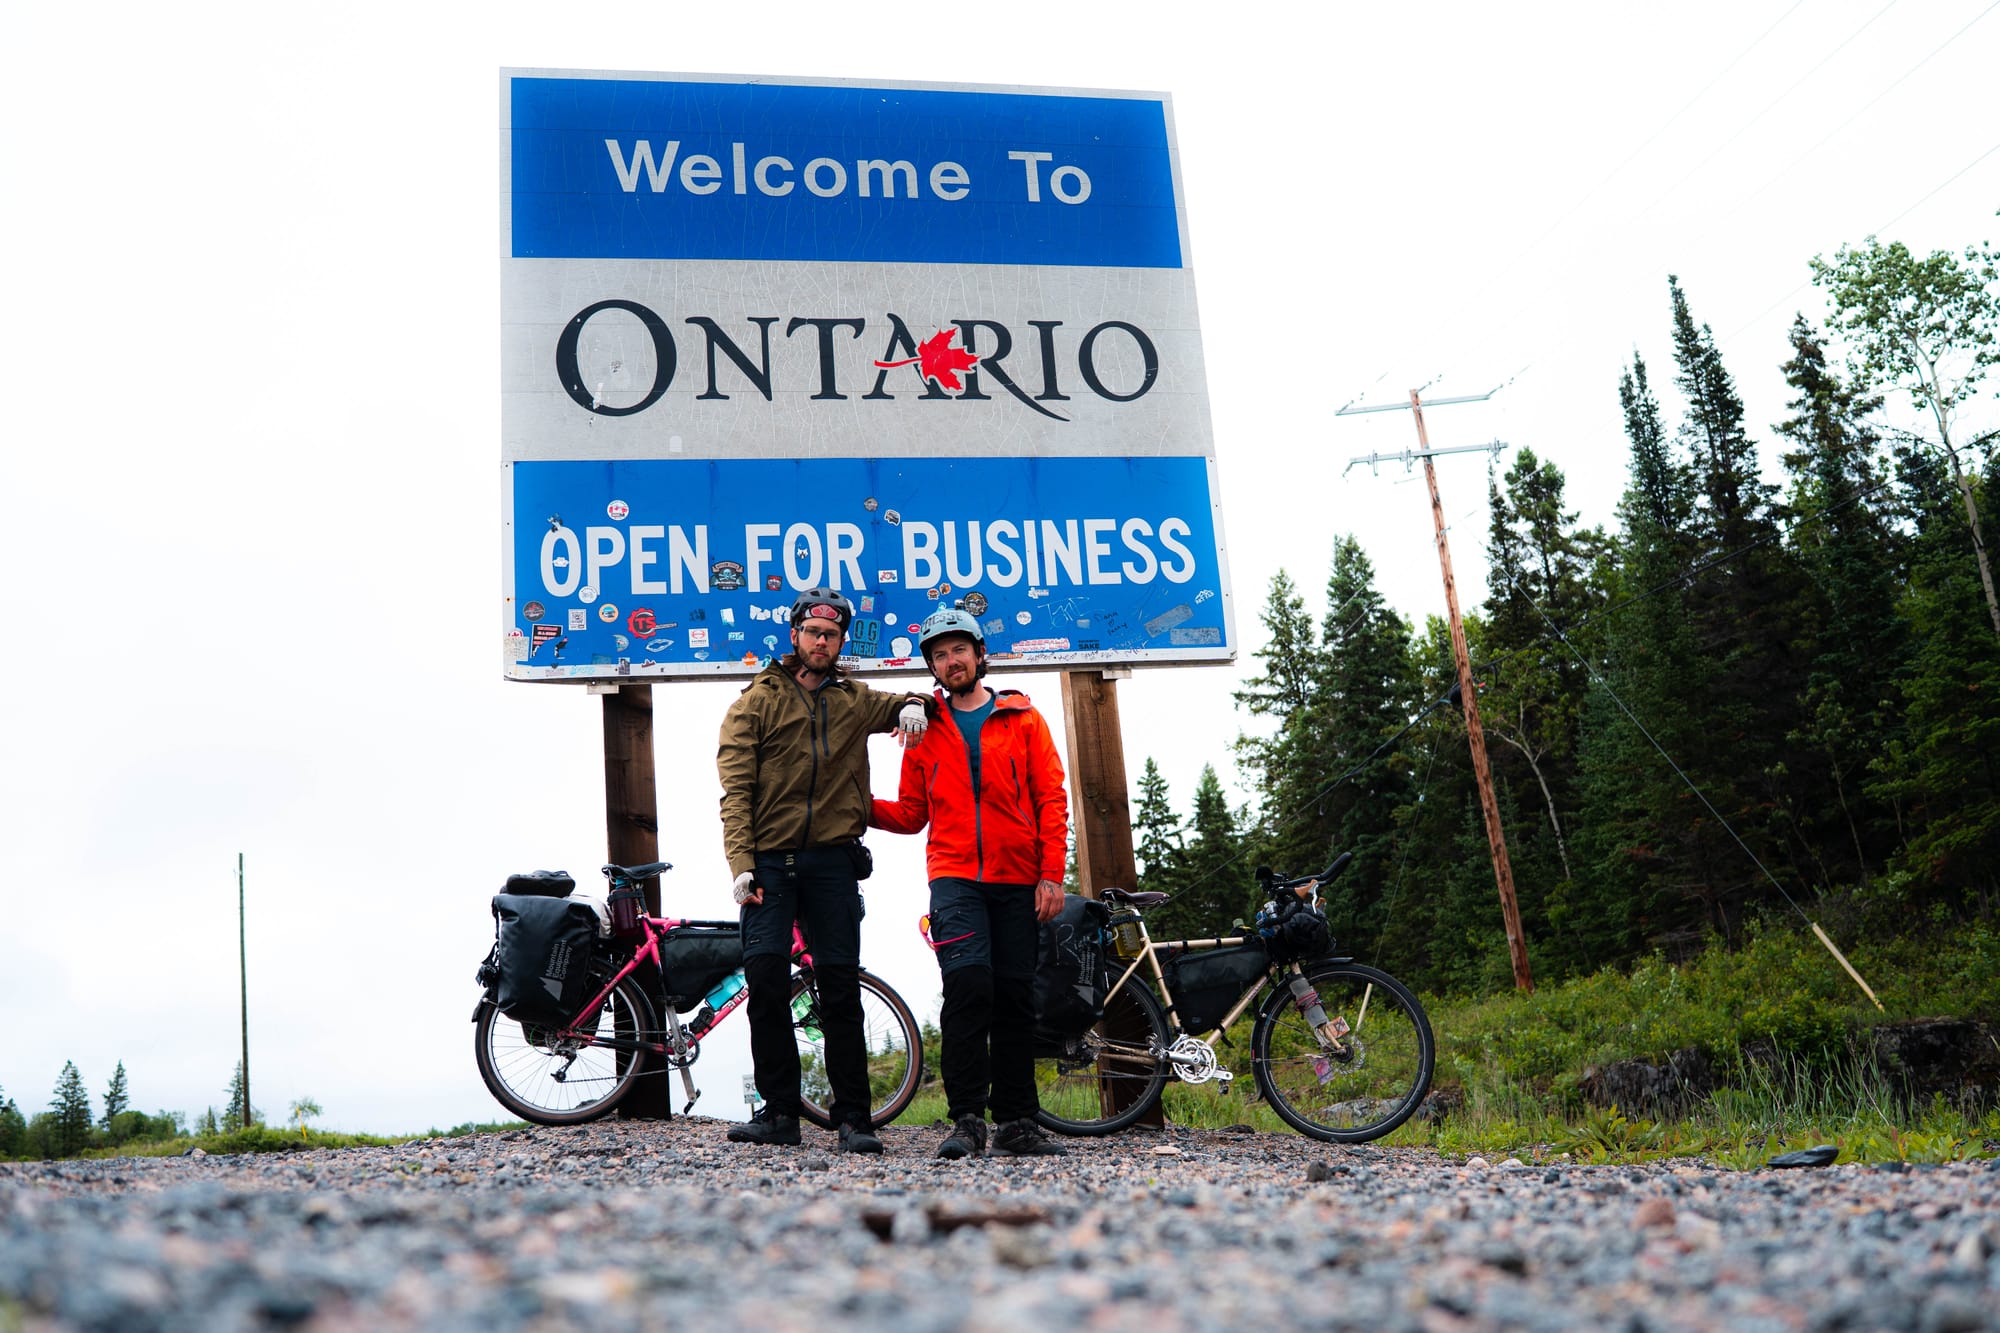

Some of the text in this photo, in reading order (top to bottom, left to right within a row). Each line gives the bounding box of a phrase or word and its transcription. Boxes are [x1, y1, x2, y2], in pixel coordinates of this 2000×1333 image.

[605, 139, 1092, 205] Welcome To
[555, 298, 1159, 422] ONTARIO
[539, 524, 710, 598] OPEN
[744, 521, 867, 592] FOR
[902, 517, 1196, 590] BUSINESS
[635, 615, 657, 630] TS
[545, 943, 560, 977] Mountain
[552, 939, 567, 978] Equipment
[559, 945, 573, 980] Company
